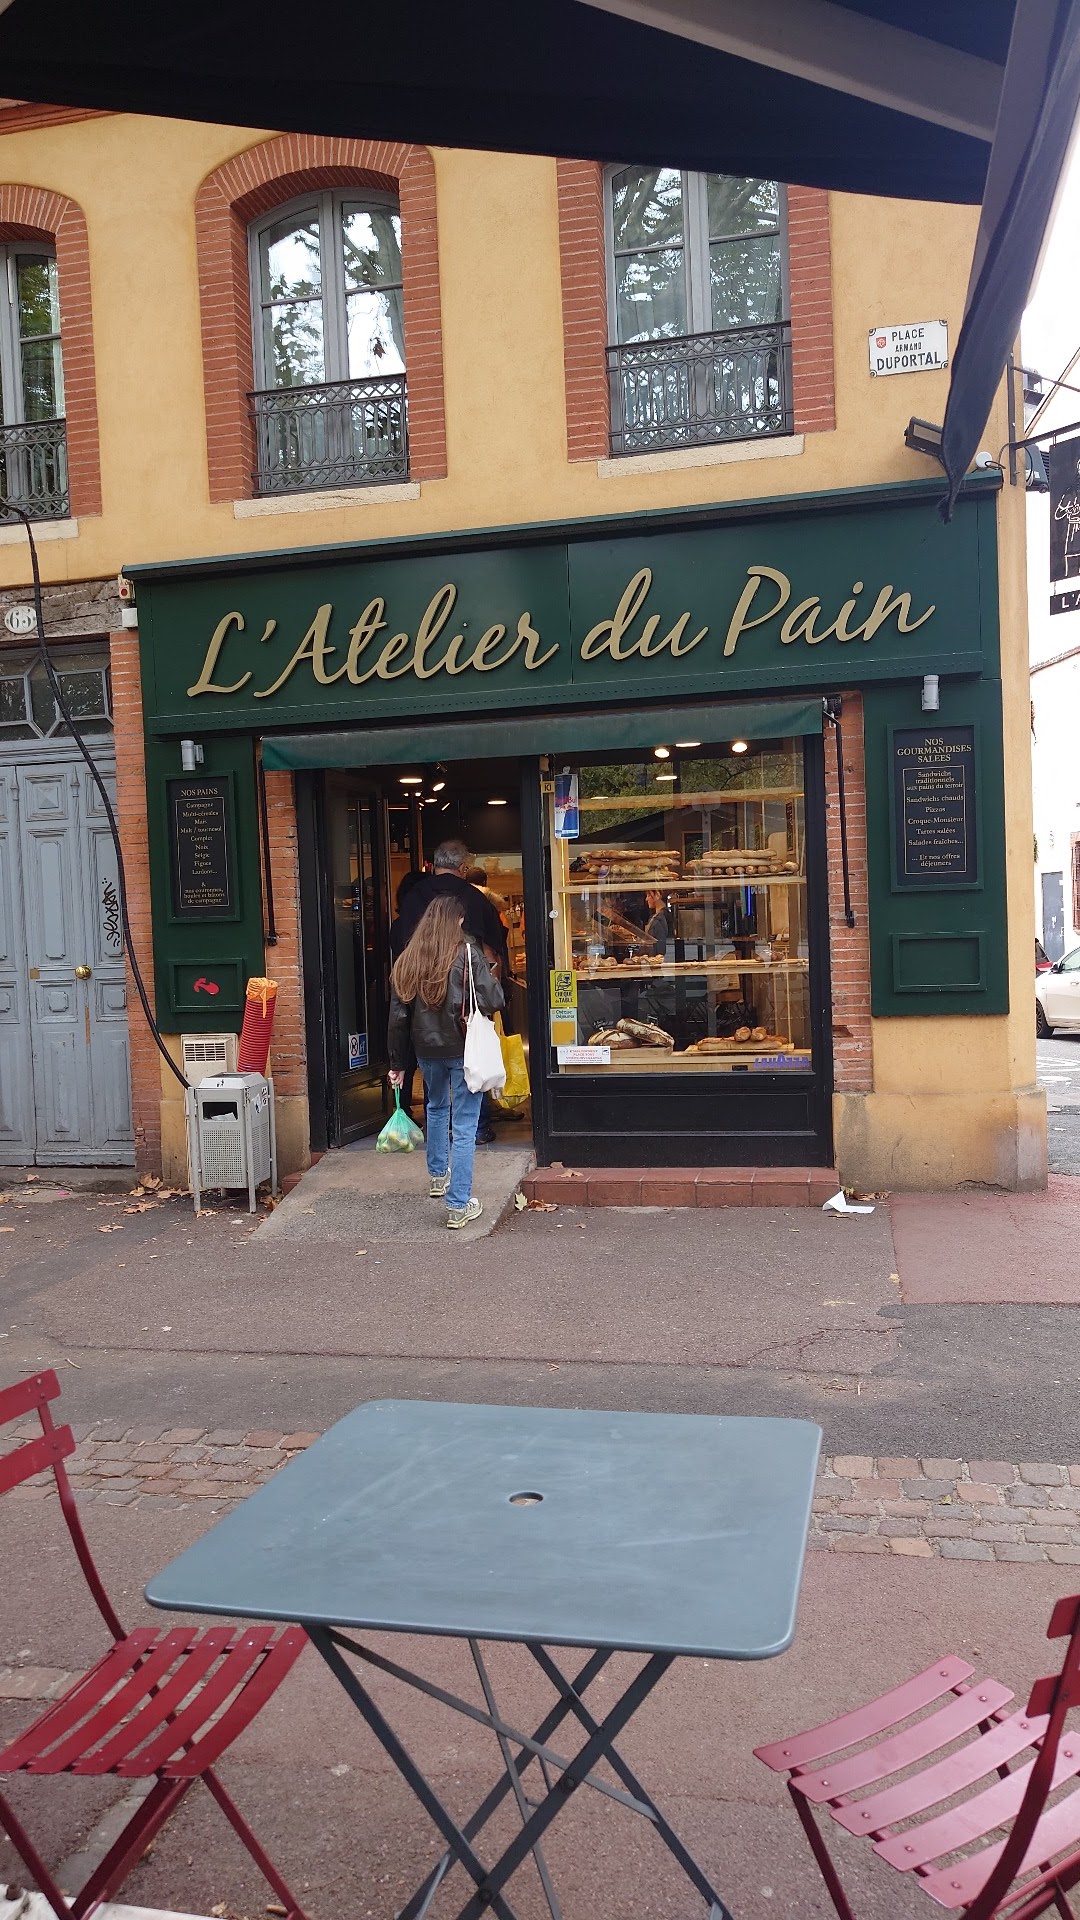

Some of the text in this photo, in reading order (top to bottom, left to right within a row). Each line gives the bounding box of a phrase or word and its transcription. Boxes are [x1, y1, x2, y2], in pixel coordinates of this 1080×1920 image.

[892, 328, 924, 341] PLACE
[895, 342, 922, 352] ARMAND
[876, 352, 941, 370] DUPORTAL
[186, 565, 936, 698] L'Atelier du Pain
[925, 738, 944, 746] NOS
[897, 744, 972, 756] GOURMANDISES
[181, 788, 218, 797] NOS PAINS
[908, 817, 963, 825] Croque-Monsieur
